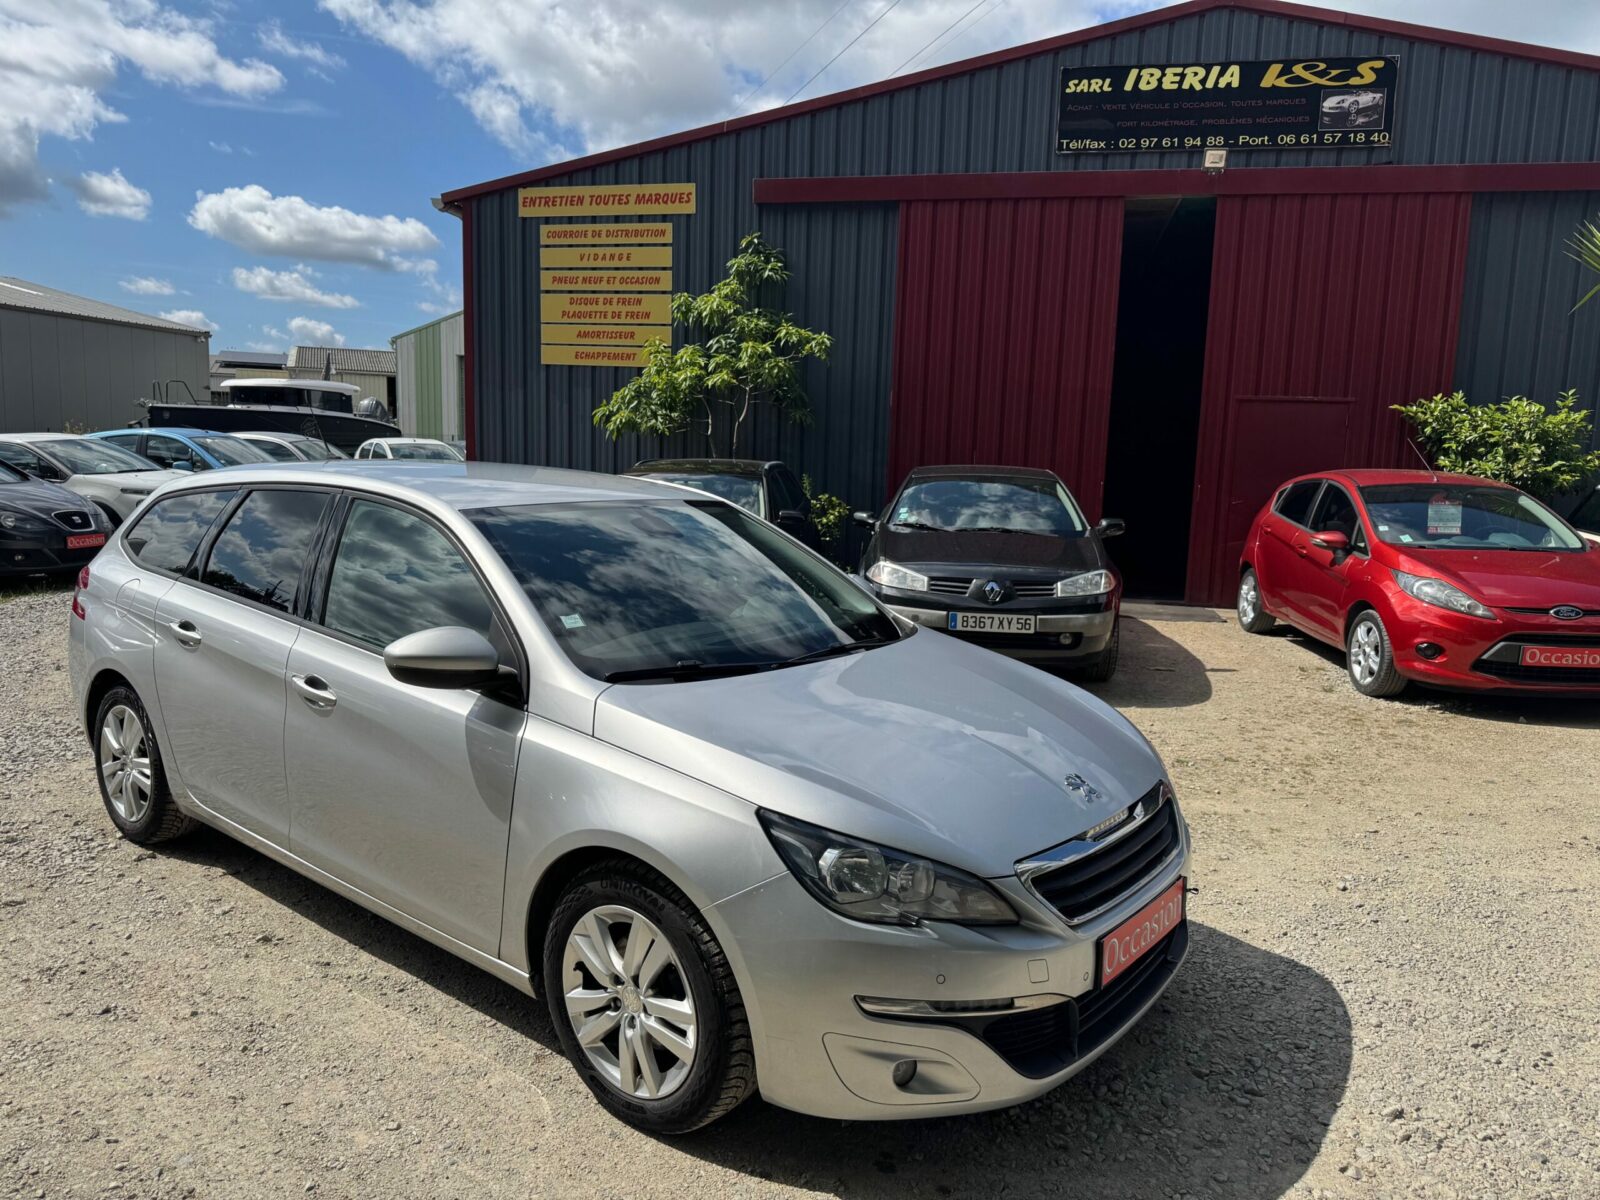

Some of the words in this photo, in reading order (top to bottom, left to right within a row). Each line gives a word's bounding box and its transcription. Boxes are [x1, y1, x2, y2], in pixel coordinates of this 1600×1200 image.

[1065, 78, 1112, 93] SARL
[1123, 65, 1240, 92] IBERIA
[1102, 103, 1127, 111] VENTE
[1231, 99, 1263, 107] TOUTES
[1060, 138, 1106, 149] Tél/fax
[1118, 138, 1137, 148] 02
[1140, 138, 1158, 148] 97
[1162, 137, 1178, 147] 61
[1184, 136, 1202, 147] 94
[1206, 136, 1224, 146] 88
[1239, 135, 1272, 145] Port.
[1277, 134, 1296, 145] 06
[1300, 134, 1317, 144] 61
[1323, 133, 1342, 143] 57
[1348, 132, 1365, 143] 18
[1369, 132, 1389, 142] 40
[521, 195, 585, 208] ENTRETIEN
[588, 193, 630, 207] TOUTES
[634, 192, 692, 206] MARQUES
[546, 229, 589, 239] COURROIE
[591, 229, 602, 238] DE
[605, 228, 666, 238] DISTRIBUTION
[579, 252, 632, 262] VIDANGE
[552, 276, 579, 285] PNEUS
[581, 276, 604, 285] NEUF
[606, 276, 617, 285] ET
[619, 276, 661, 285] OCCASION
[569, 297, 600, 306] DISQUE
[602, 297, 614, 306] DE
[616, 297, 643, 306] FREIN
[561, 310, 608, 319] PLAQUETTE
[611, 311, 622, 319] DE
[624, 311, 651, 320] FREIN
[576, 330, 636, 340] AMORTISSEUR
[574, 351, 637, 361] ECHAPPEMENT
[69, 535, 105, 547] Occasion
[1558, 608, 1576, 618] Ford
[961, 615, 995, 629] 8367
[997, 616, 1014, 630] XY
[1016, 617, 1032, 631] 56
[1104, 894, 1182, 976] Occasion
